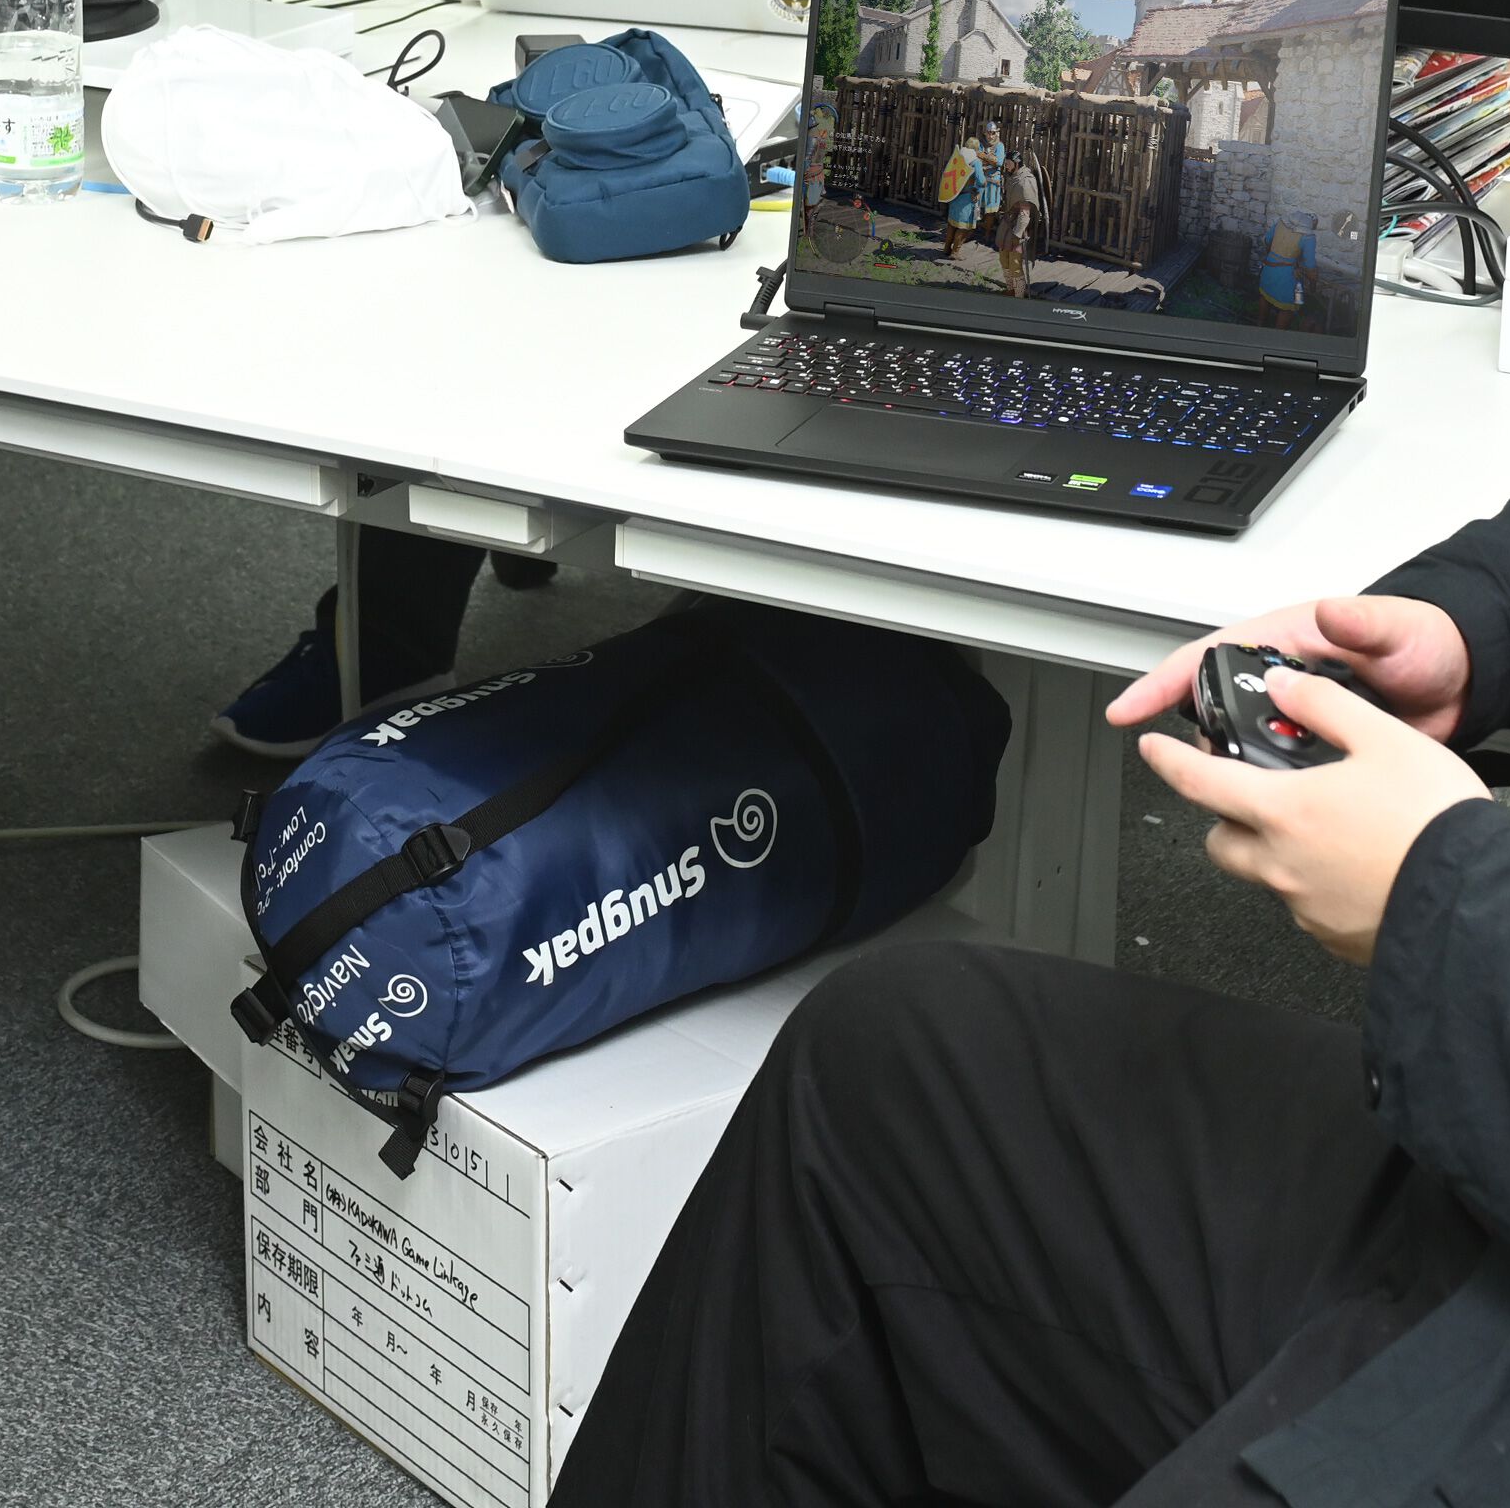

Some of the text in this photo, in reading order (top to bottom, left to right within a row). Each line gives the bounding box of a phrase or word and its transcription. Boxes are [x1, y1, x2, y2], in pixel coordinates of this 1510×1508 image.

[1052, 307, 1087, 322] HYPERX
[522, 845, 706, 986] Snugpak
[253, 1124, 319, 1193] 会社名
[254, 1164, 319, 1234] 部門
[256, 1229, 319, 1299] 保存期限
[257, 1293, 320, 1360] 内容
